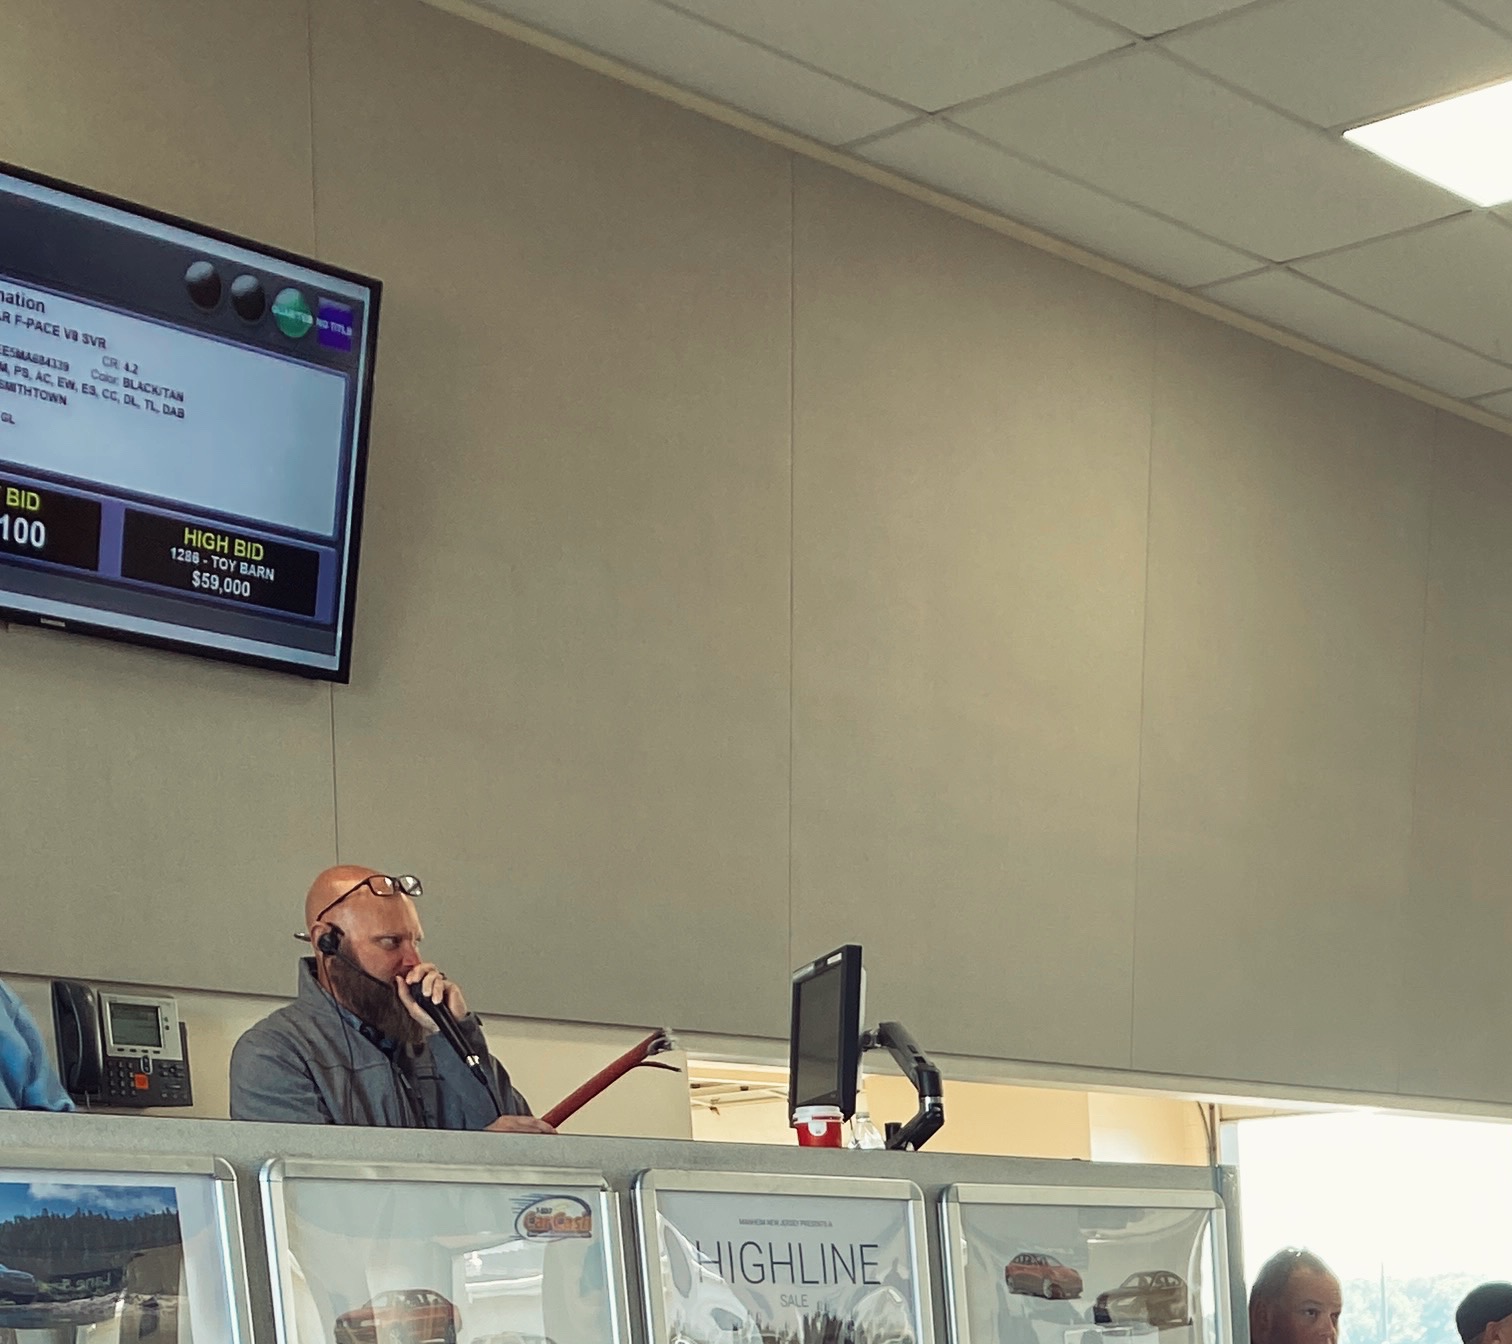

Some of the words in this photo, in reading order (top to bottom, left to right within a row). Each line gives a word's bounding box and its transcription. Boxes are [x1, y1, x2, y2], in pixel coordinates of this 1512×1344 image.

[14, 314, 60, 337] F-PACE
[82, 333, 107, 349] SVR
[123, 377, 184, 402] BLACK/TAN
[6, 487, 40, 512] BID
[184, 527, 229, 554] HIGH
[234, 539, 265, 561] BID
[211, 555, 236, 573] TOY
[239, 563, 275, 581] BARN
[192, 570, 250, 598] $59,000
[696, 1239, 882, 1285] HIGHLINE
[780, 1294, 809, 1308] SALE
